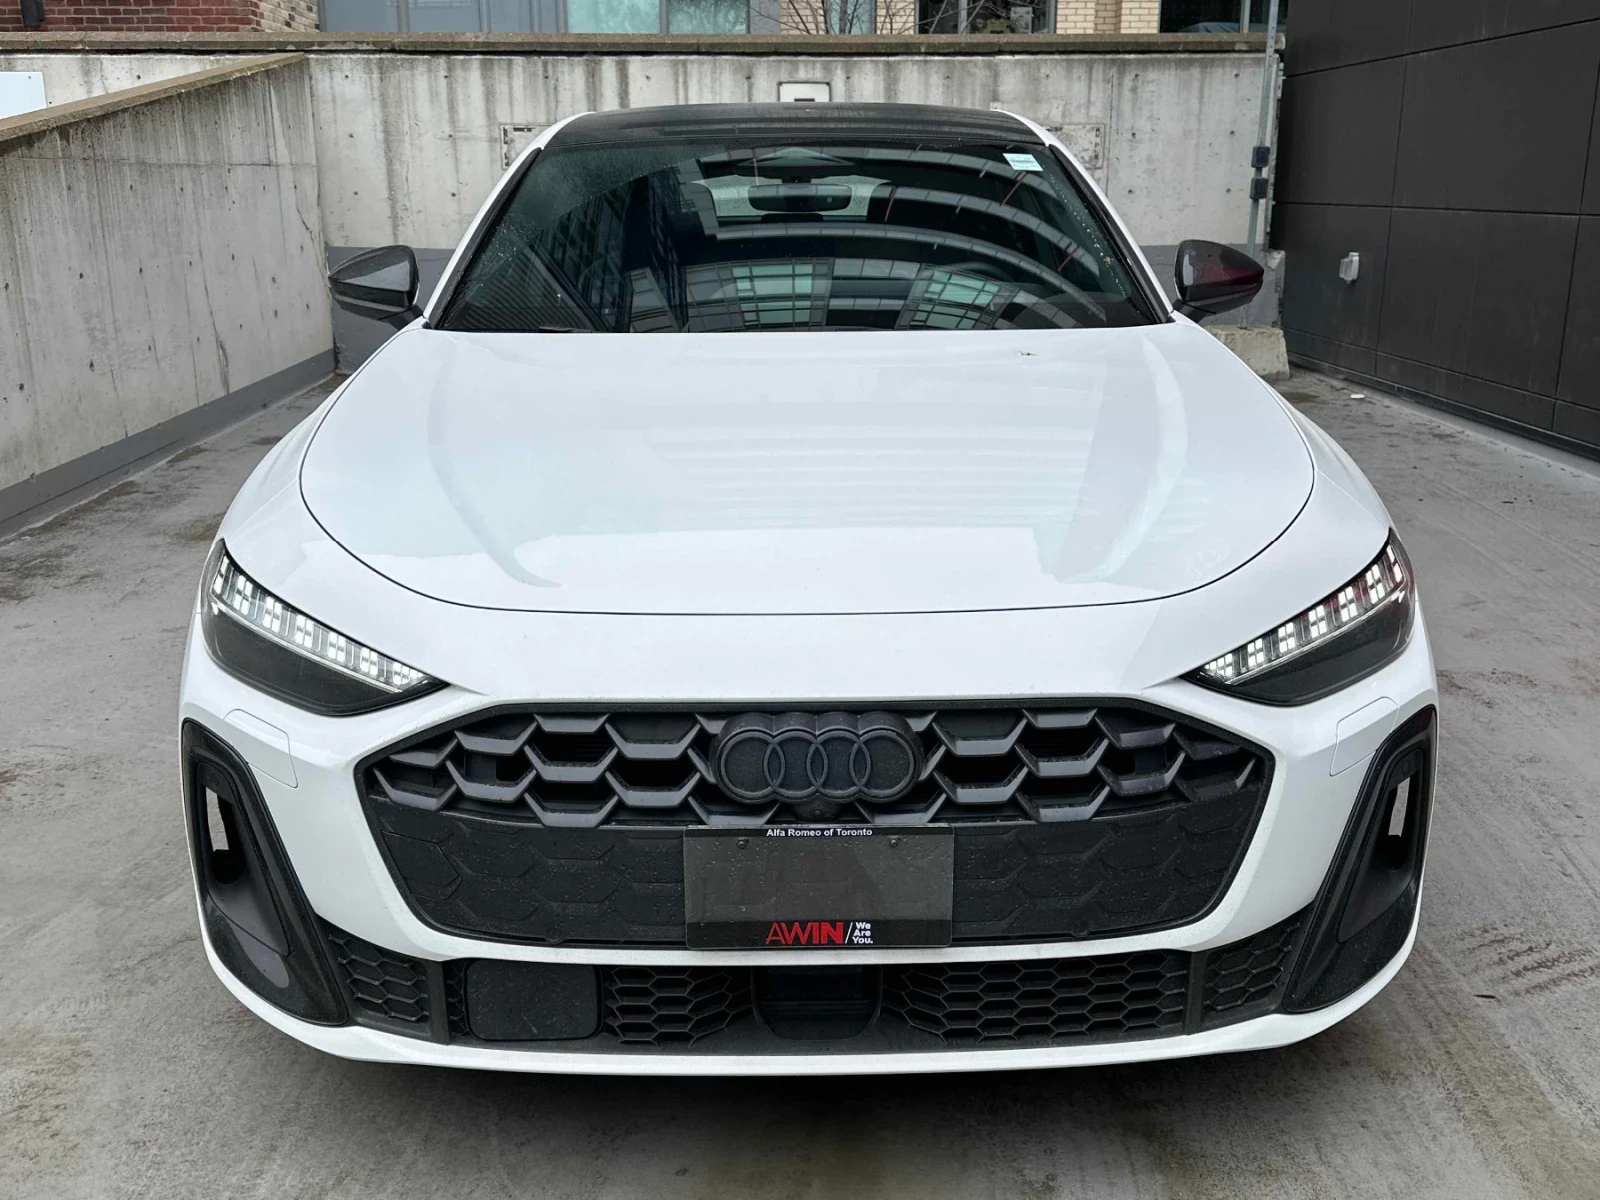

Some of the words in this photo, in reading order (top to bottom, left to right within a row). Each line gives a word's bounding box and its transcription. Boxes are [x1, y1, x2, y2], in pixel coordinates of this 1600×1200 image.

[766, 828, 785, 837] Alfa
[788, 828, 821, 837] Romeo
[823, 828, 833, 836] of
[835, 828, 873, 836] Toronto
[855, 922, 871, 930] We
[765, 921, 844, 944] AWIN
[853, 929, 871, 937] Are
[852, 936, 874, 944] You.
